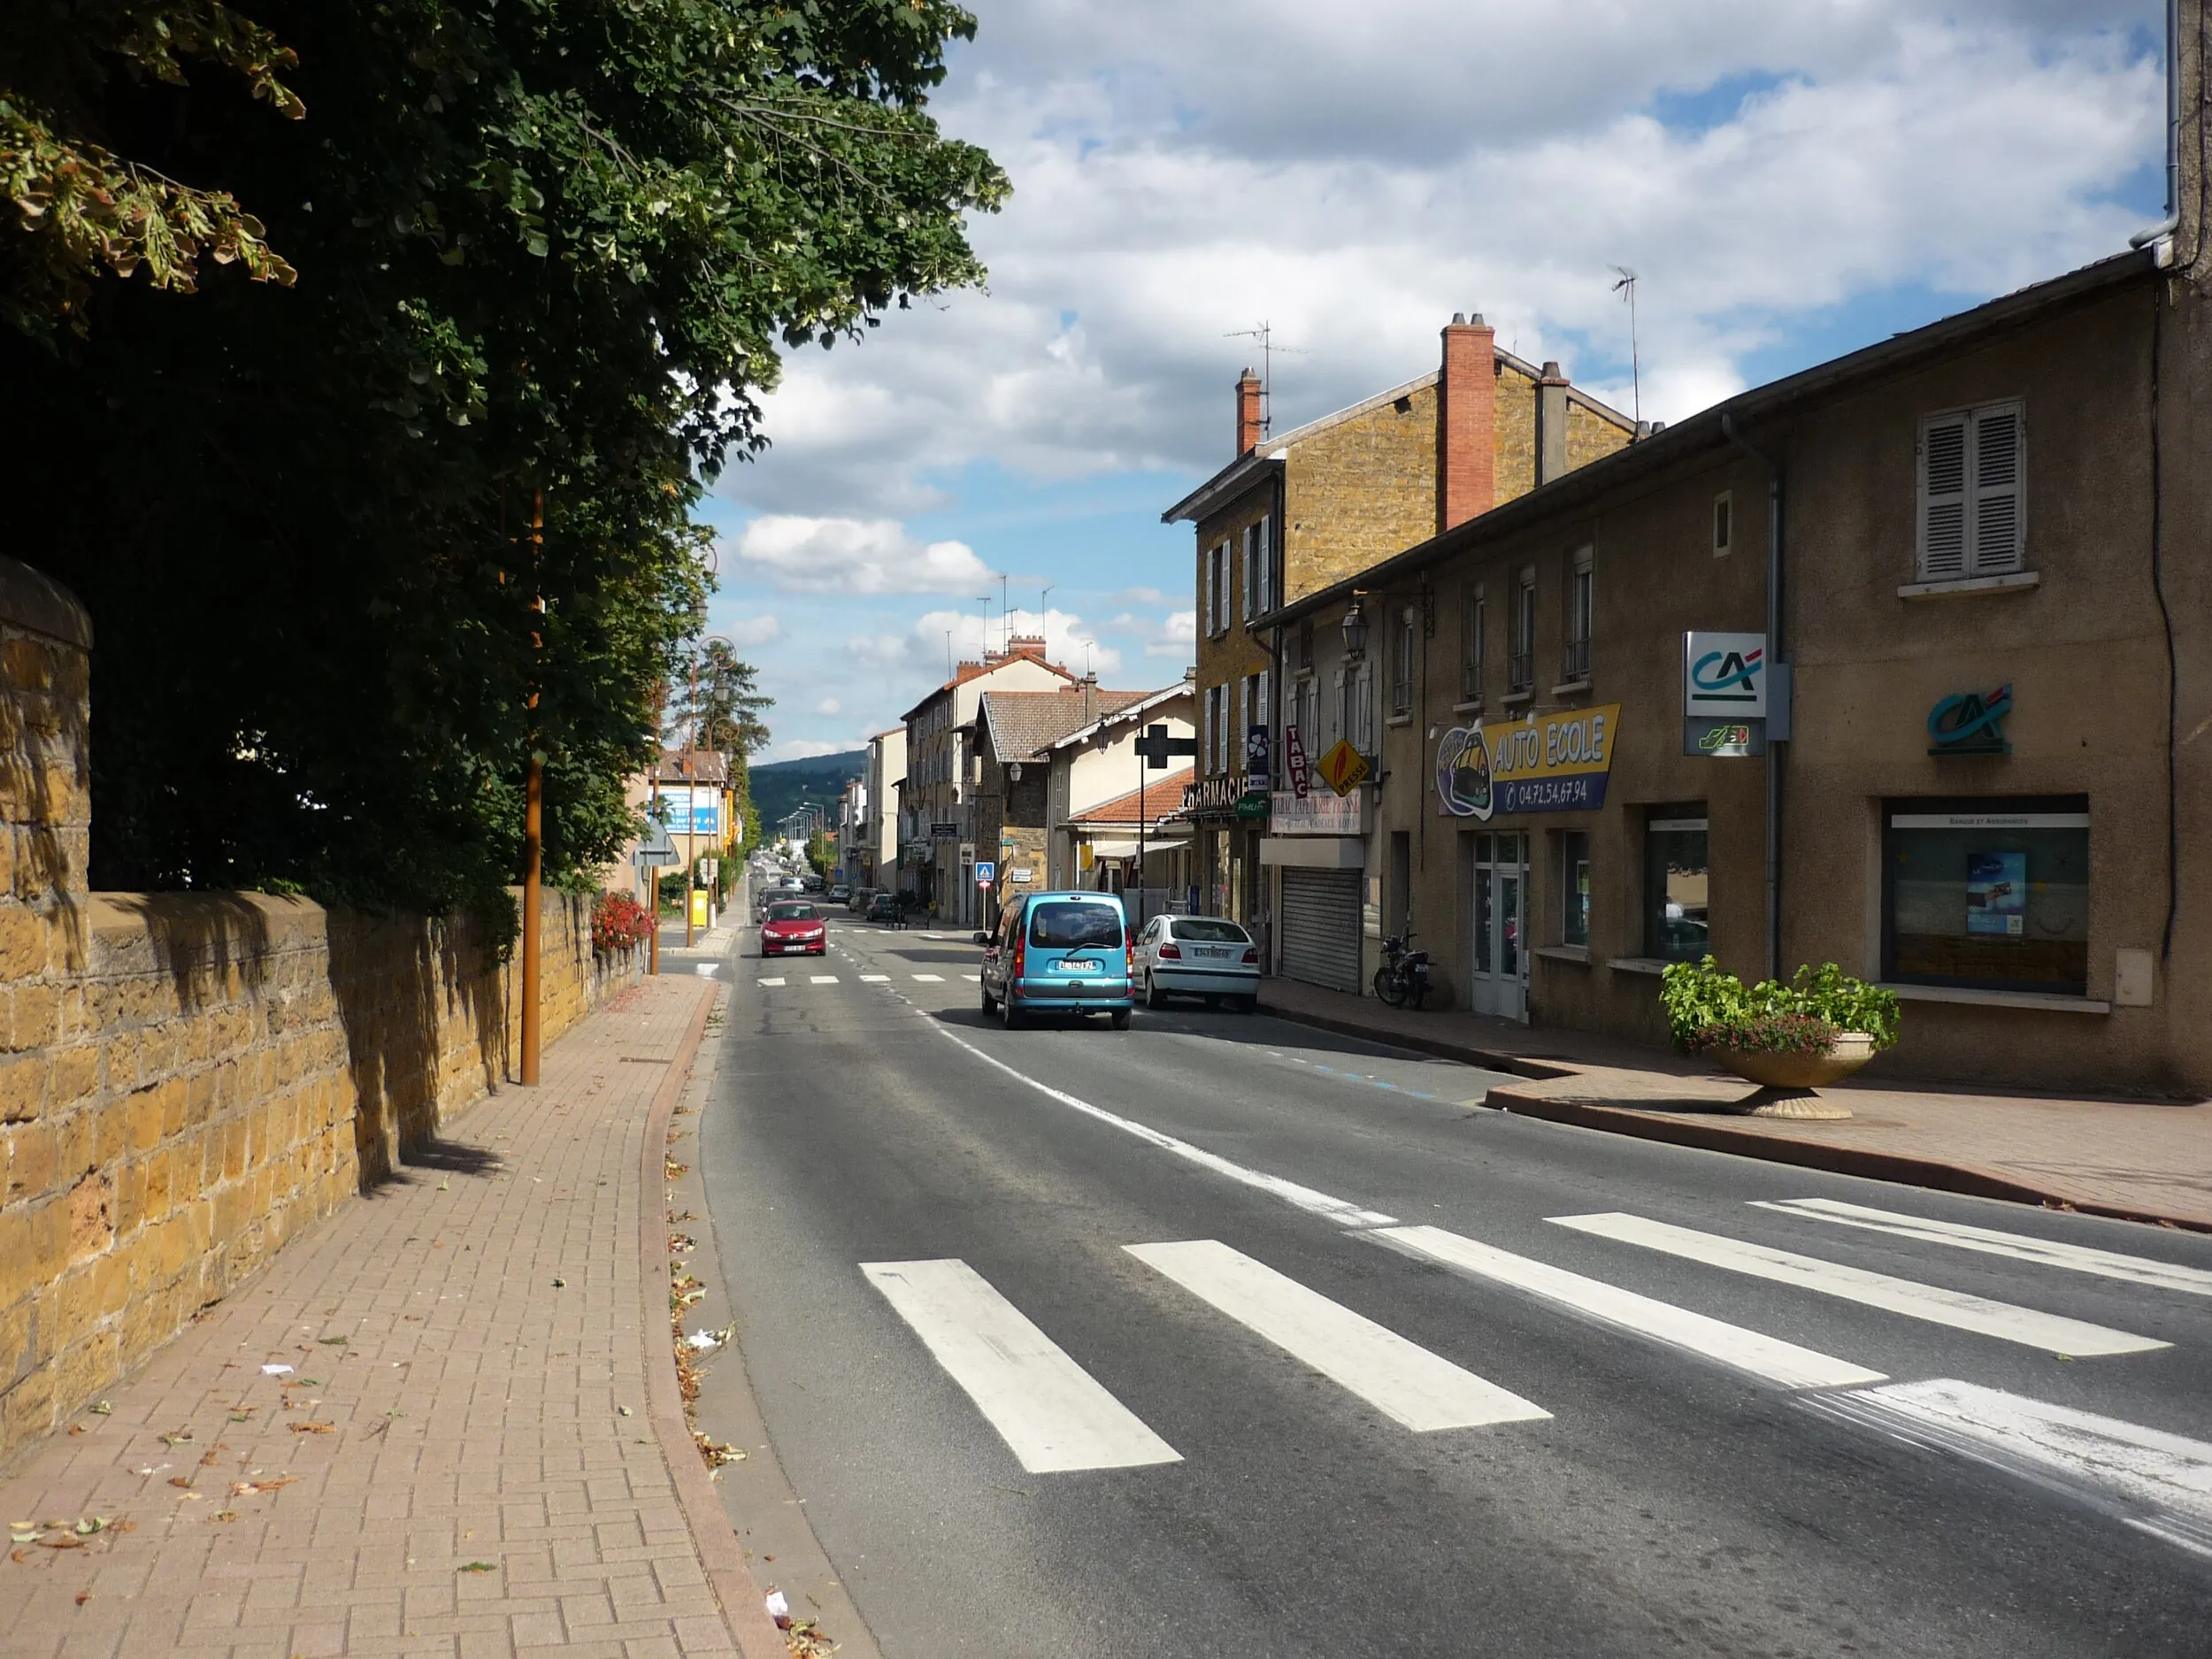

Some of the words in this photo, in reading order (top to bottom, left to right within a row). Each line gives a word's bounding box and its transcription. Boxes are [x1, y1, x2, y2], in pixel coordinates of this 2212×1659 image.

[1493, 728, 1540, 772] AUTO
[1547, 714, 1605, 767] ECOLE
[1288, 727, 1306, 795] TABAC
[1338, 763, 1367, 793] PRESSE
[1518, 780, 1587, 805] 04.72.54.67.94
[1181, 777, 1248, 810] PHARMACIE
[1238, 803, 1257, 811] PMU
[1272, 797, 1292, 815] TABAC
[1333, 794, 1359, 814] PRESSE
